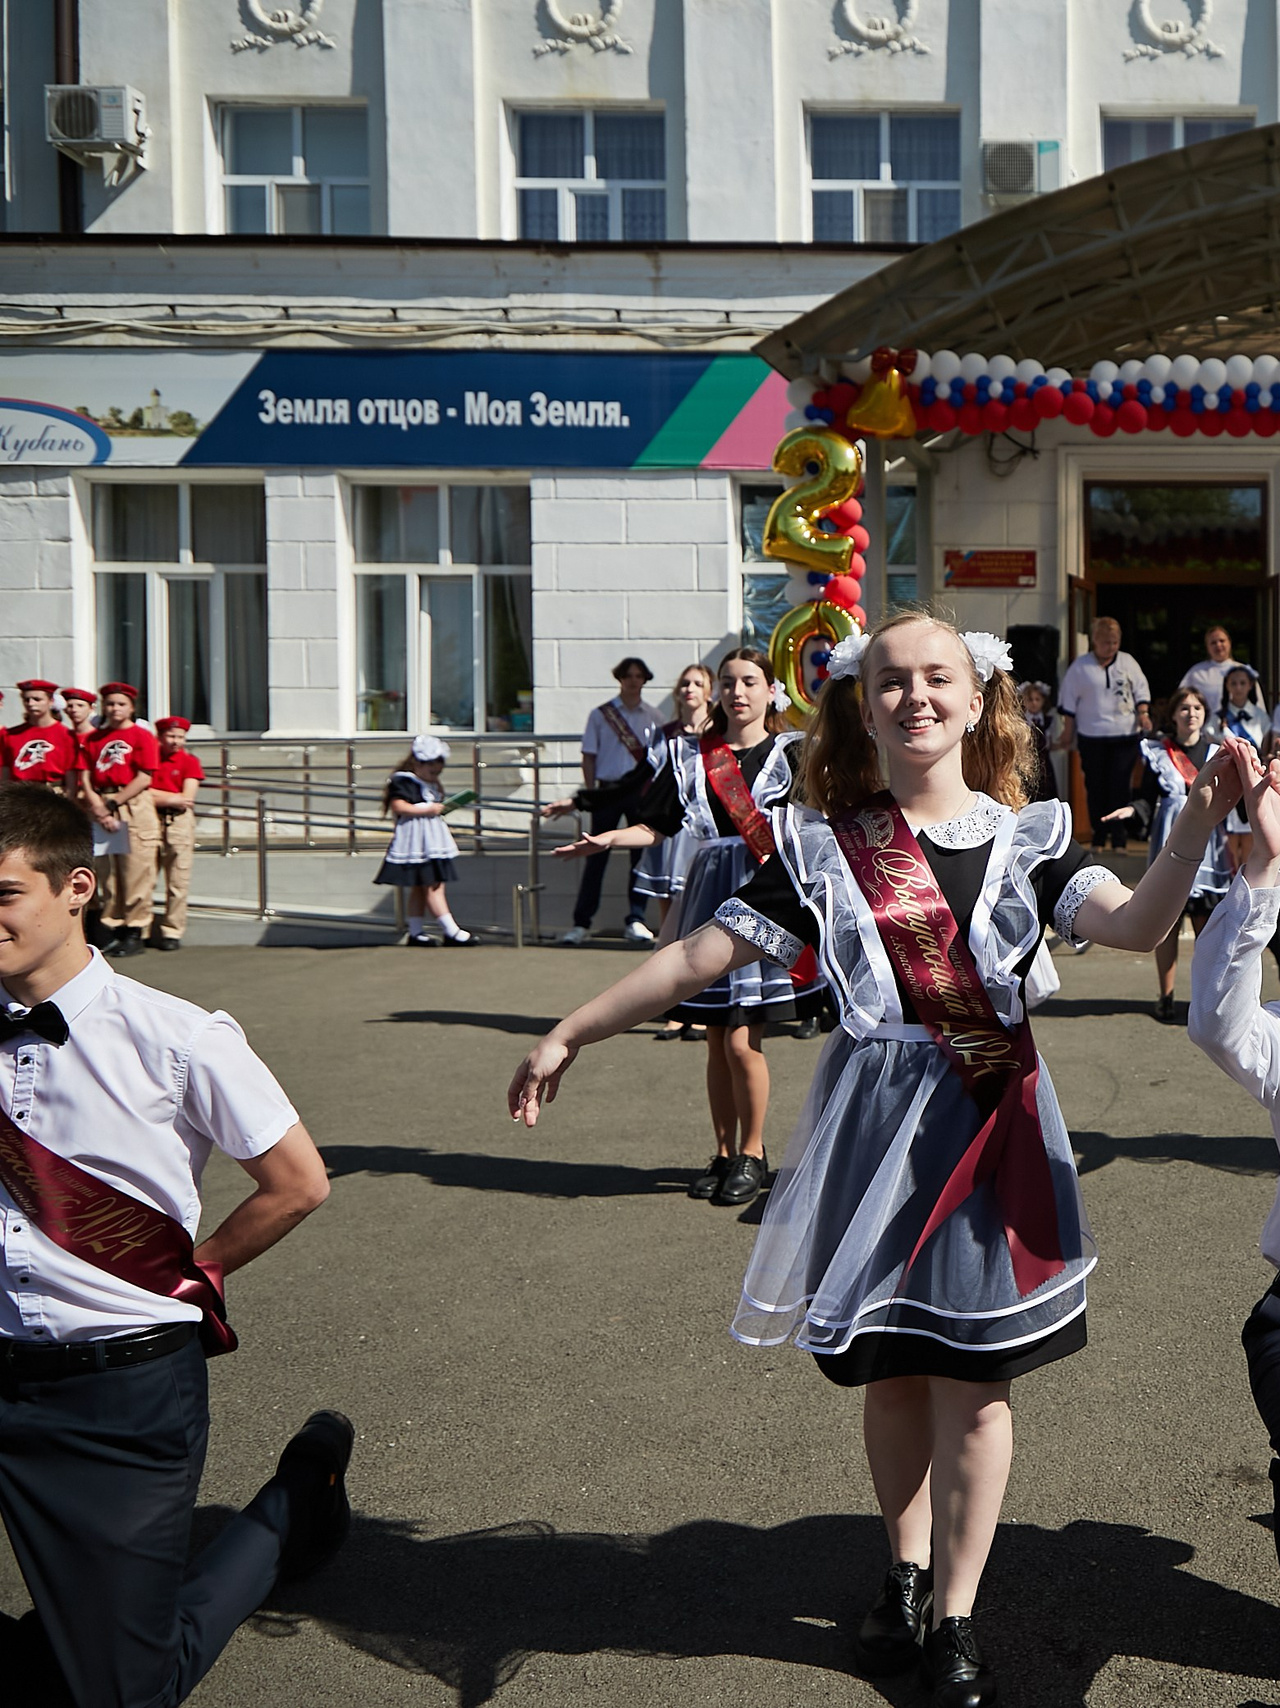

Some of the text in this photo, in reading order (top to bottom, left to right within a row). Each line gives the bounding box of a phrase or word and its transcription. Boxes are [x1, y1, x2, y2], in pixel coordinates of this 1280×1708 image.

[257, 389, 350, 425] Земля
[358, 398, 440, 431] отцов
[464, 391, 522, 426] Моя
[529, 391, 630, 427] Земля.
[872, 849, 1022, 1078] Выпускница 2024
[51, 1197, 167, 1262] 2024
